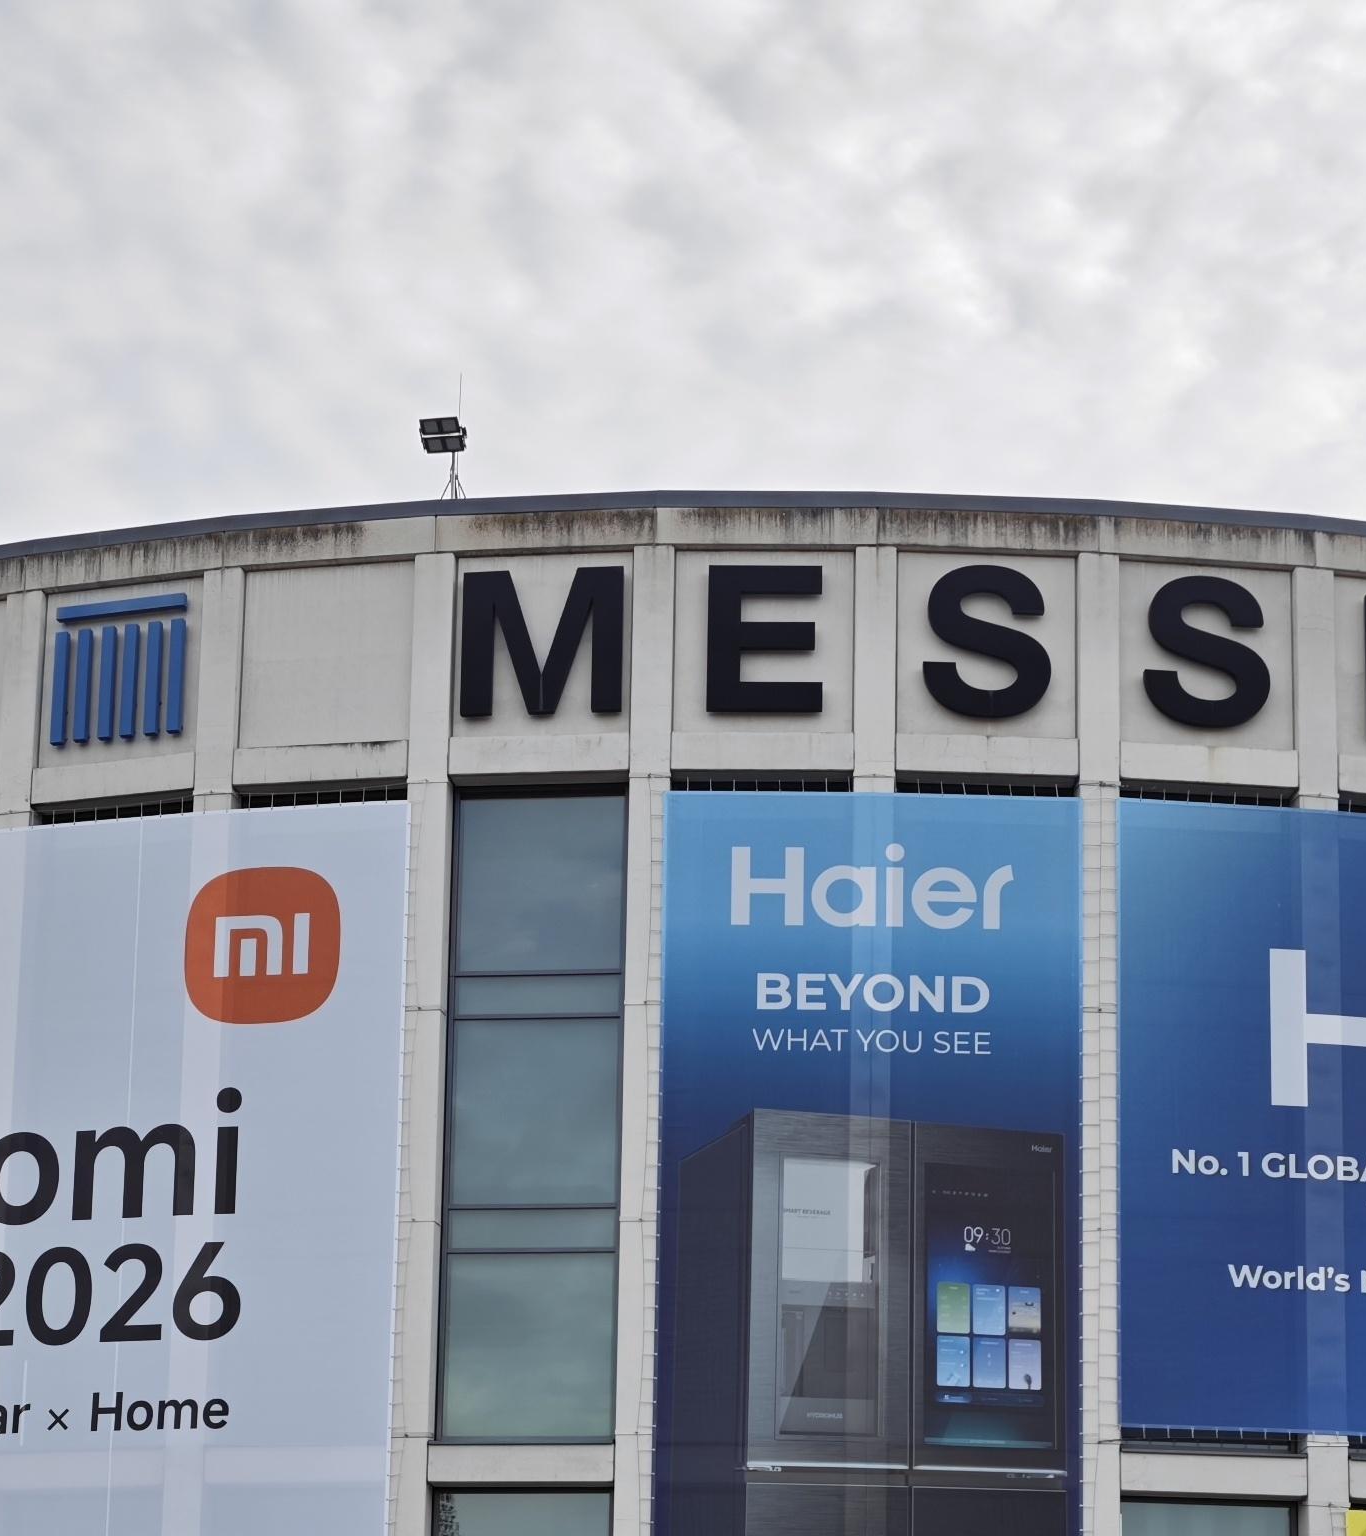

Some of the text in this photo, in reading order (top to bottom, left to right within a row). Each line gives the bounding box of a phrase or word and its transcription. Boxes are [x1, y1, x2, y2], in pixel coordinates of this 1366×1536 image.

[730, 843, 1014, 930] Haier
[756, 972, 990, 1013] BEYOND
[752, 1028, 991, 1055] WHAT YOU SEE
[1170, 1148, 1228, 1177] No.
[1237, 1151, 1250, 1177] 1
[964, 1226, 1011, 1246] 09:30
[1228, 1263, 1350, 1295] World's
[90, 1391, 230, 1432] Home
